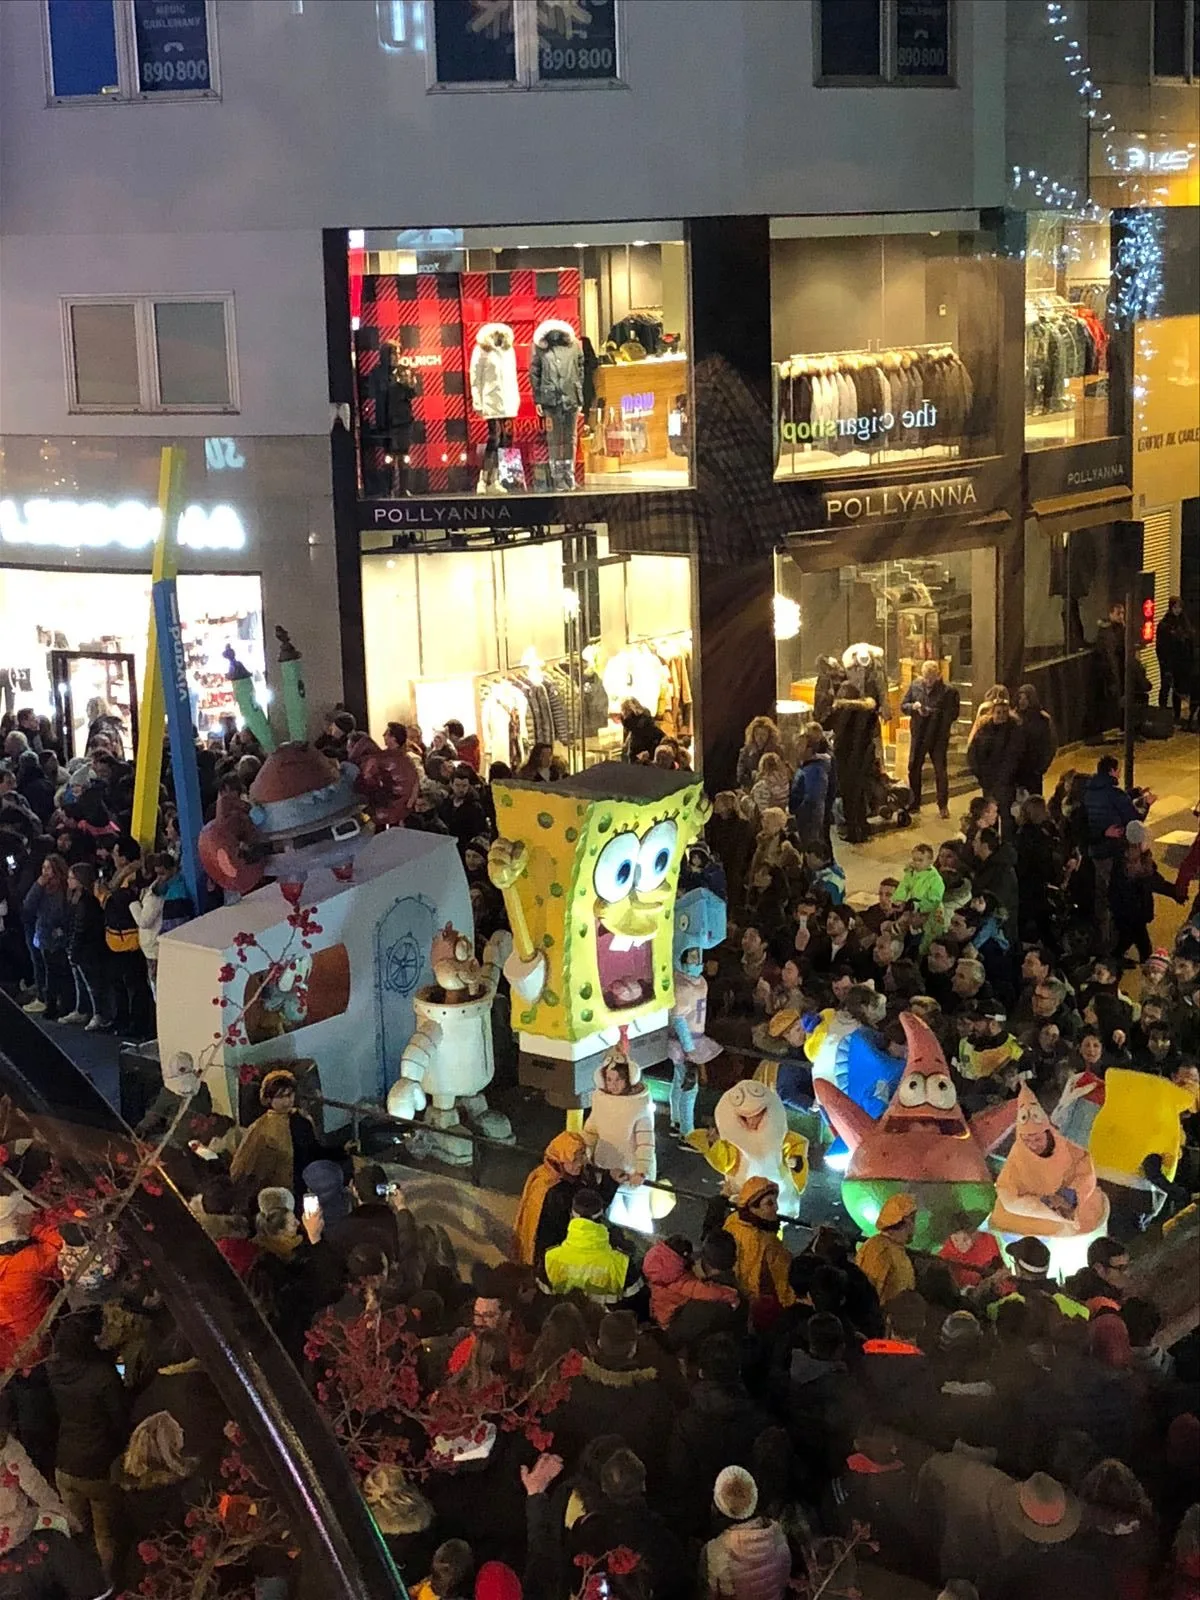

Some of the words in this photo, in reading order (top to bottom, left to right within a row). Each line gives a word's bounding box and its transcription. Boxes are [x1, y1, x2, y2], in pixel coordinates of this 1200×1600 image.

[1067, 463, 1124, 485] POLLYANNA
[373, 505, 512, 523] POLLYANNA
[826, 483, 978, 521] POLLYANNA
[168, 625, 188, 701] vivand
